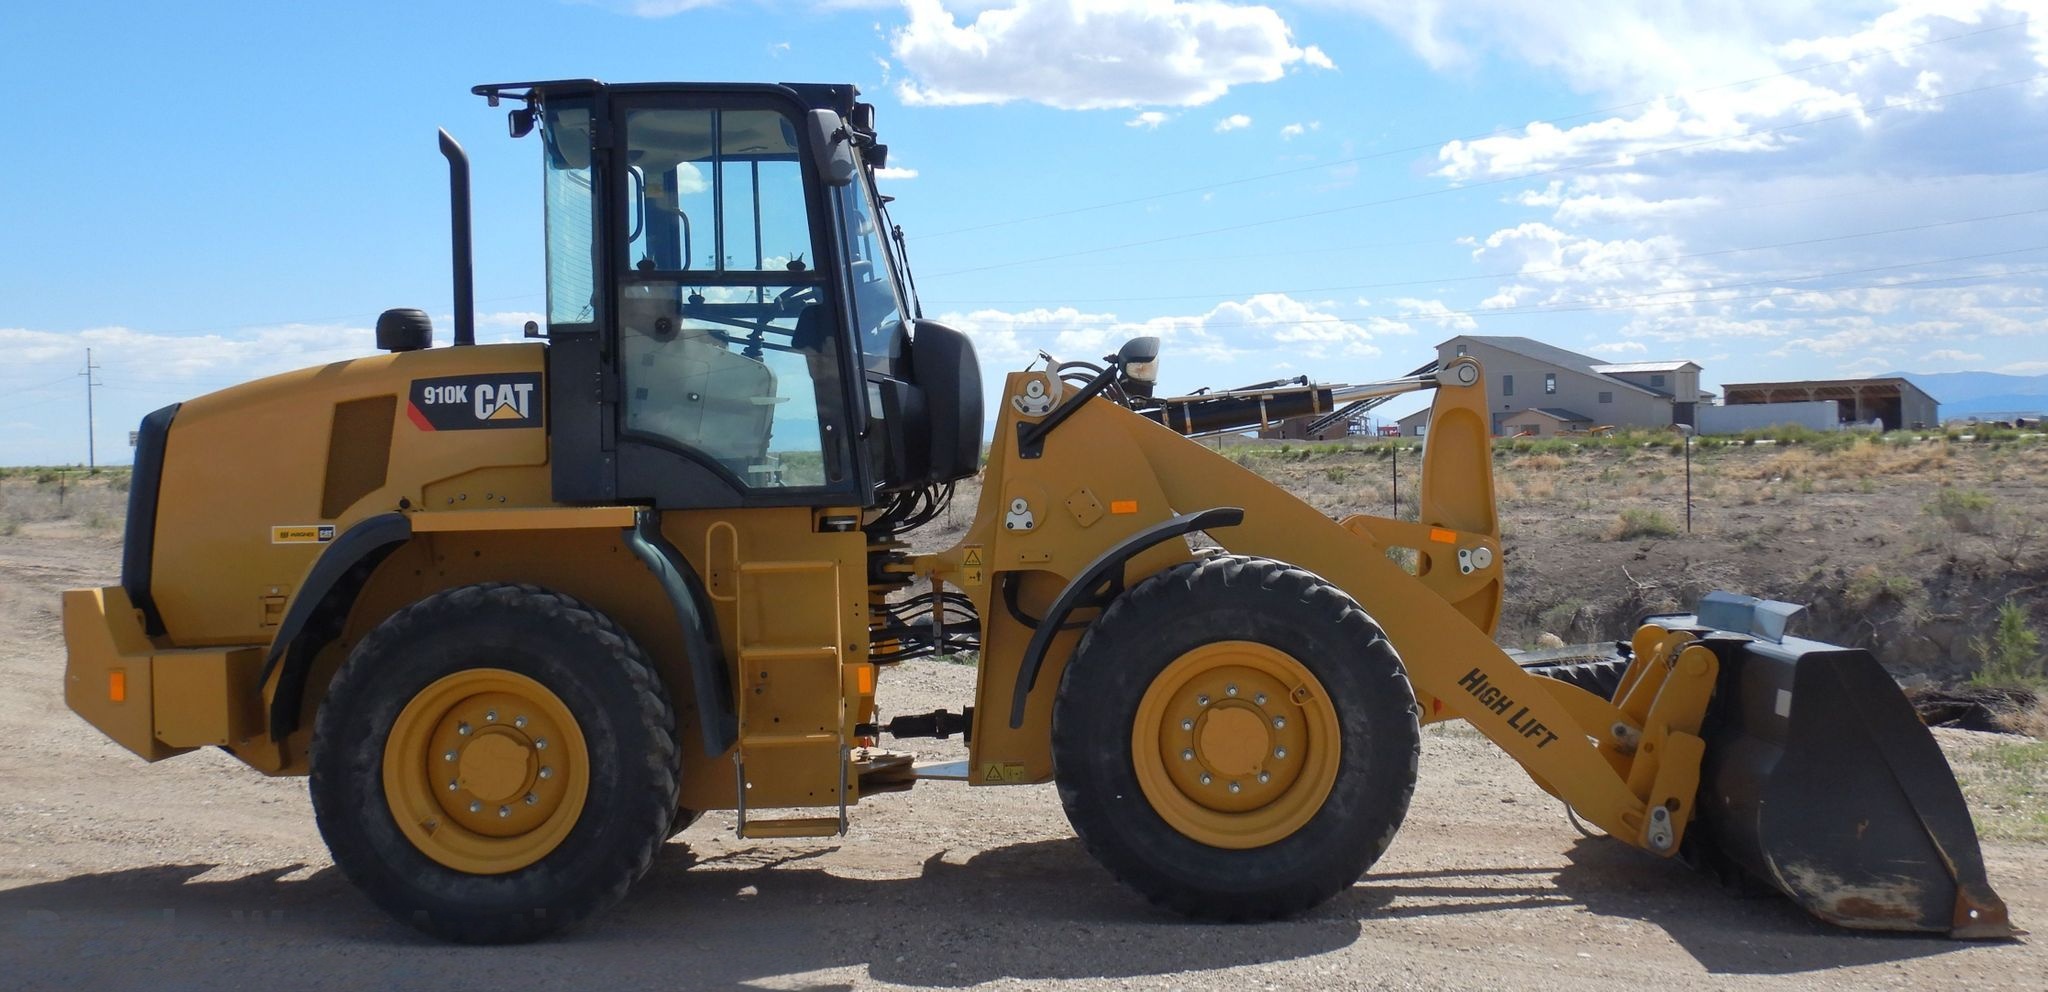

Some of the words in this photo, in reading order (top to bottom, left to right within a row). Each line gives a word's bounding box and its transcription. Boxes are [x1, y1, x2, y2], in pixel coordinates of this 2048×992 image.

[424, 385, 469, 405] 910K
[474, 383, 534, 420] CAT
[1457, 667, 1515, 716] HIGH
[1506, 706, 1559, 749] LIFT
